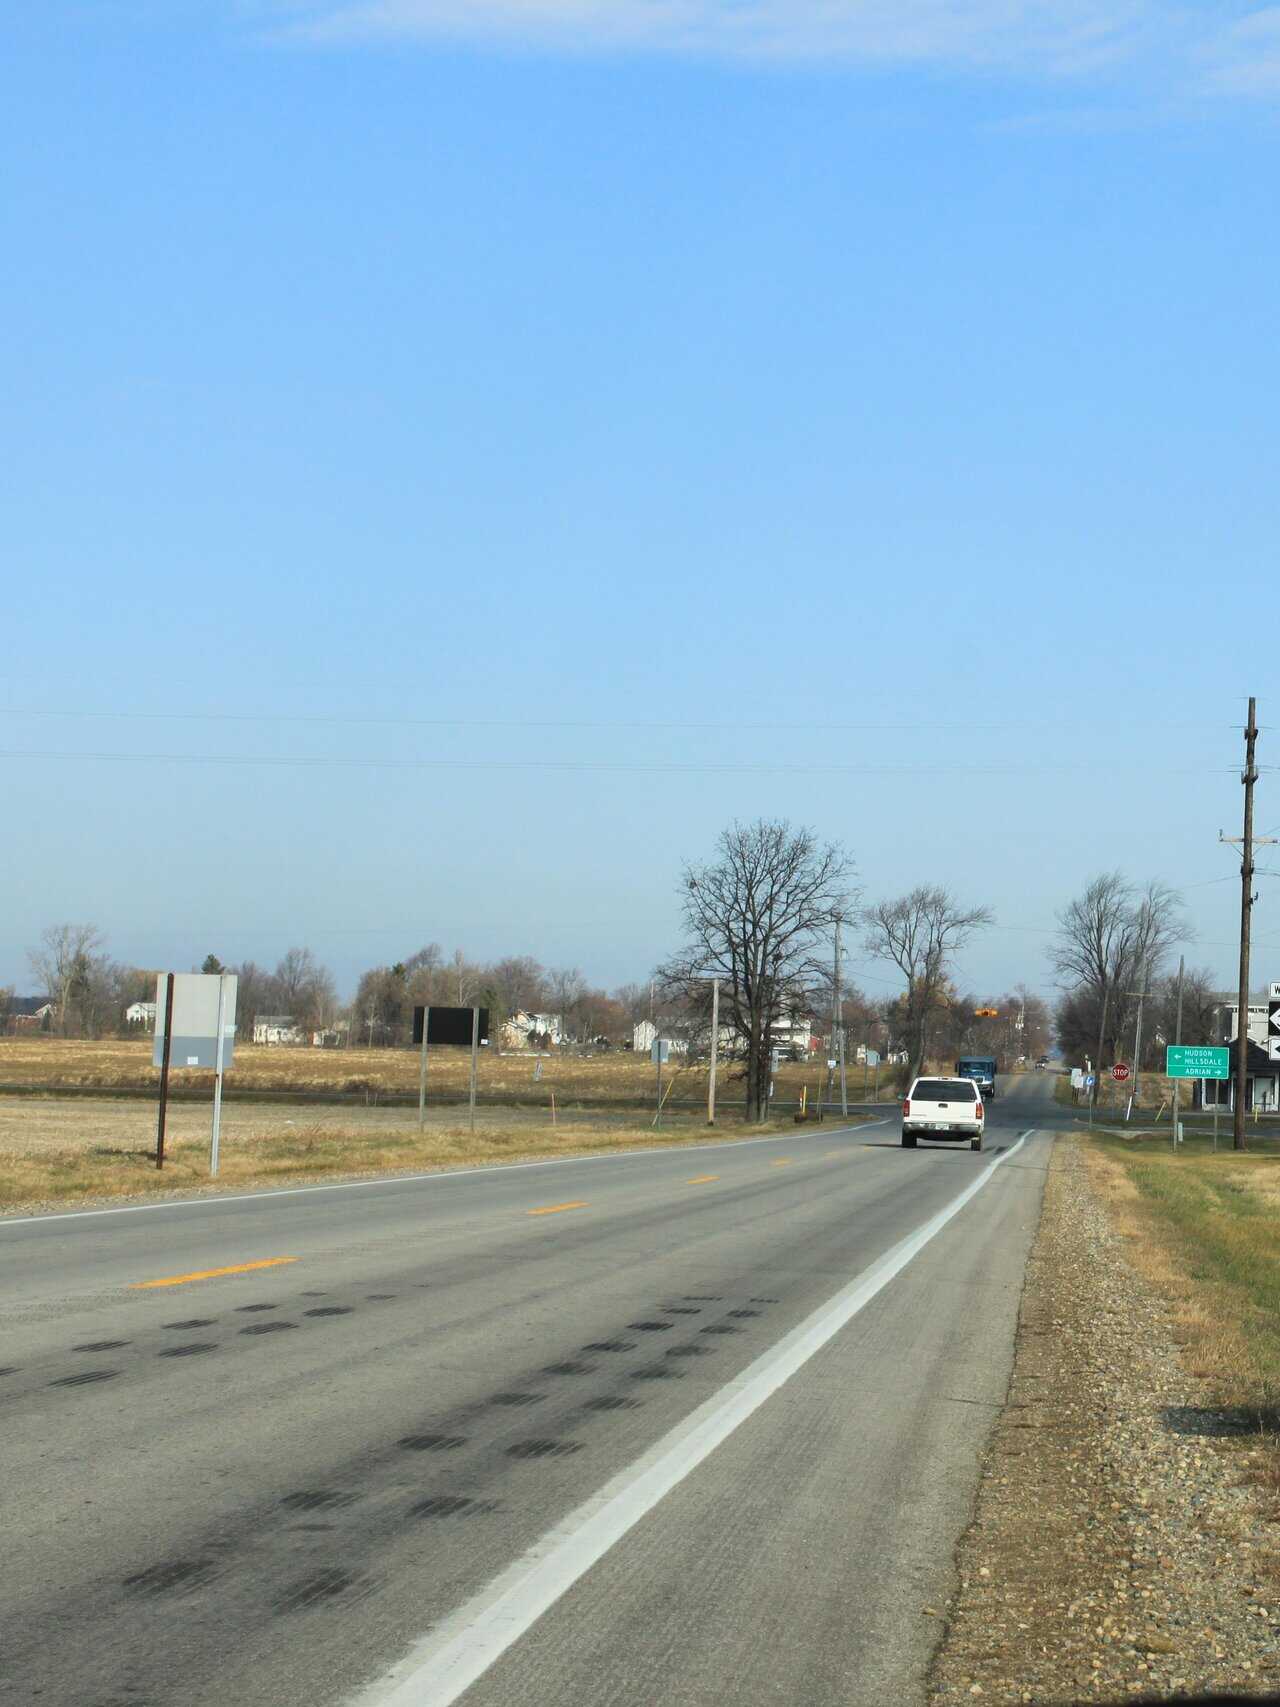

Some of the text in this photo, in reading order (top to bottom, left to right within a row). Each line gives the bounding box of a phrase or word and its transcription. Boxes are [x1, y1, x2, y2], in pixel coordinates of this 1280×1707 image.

[1184, 1049, 1213, 1057] HUDSON
[1113, 1068, 1128, 1077] STOP
[1185, 1067, 1211, 1075] ADRIAN
